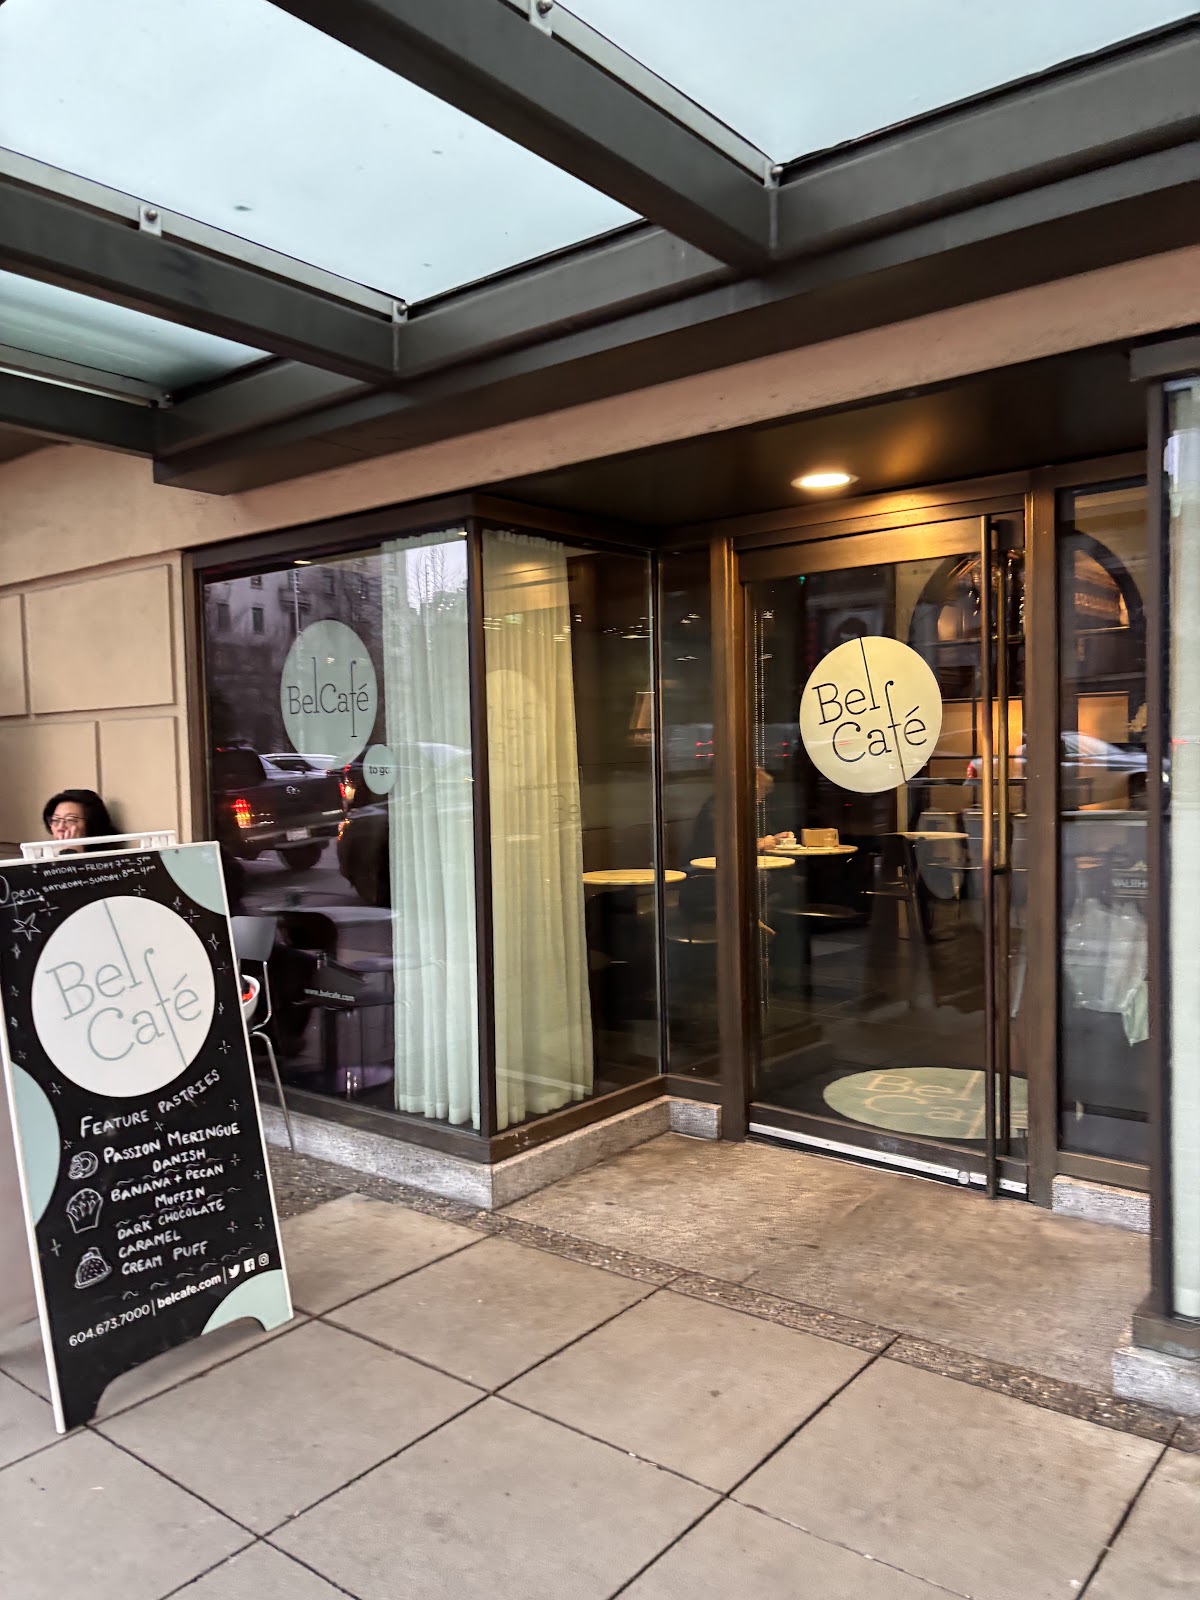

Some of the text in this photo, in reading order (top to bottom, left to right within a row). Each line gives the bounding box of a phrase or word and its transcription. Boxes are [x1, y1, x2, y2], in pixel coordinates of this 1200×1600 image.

[812, 637, 881, 725] Bel
[832, 680, 928, 784] Café
[45, 899, 143, 1021] Bel
[87, 947, 202, 1068] Café
[80, 1069, 221, 1138] FEATURE PASTRIES
[103, 1122, 241, 1164] PASSION MERINGUE
[152, 1148, 207, 1173] DANISH
[110, 1177, 172, 1202] BANANA
[185, 1164, 224, 1181] PECAN
[155, 1186, 206, 1209] MUFFIN
[117, 1198, 226, 1240] DARK CHOCOLATE
[118, 1229, 182, 1259] CARAMEL
[121, 1240, 209, 1276] CREAM PUFF
[68, 1273, 222, 1347] 604.673.7000 belcafe.com
